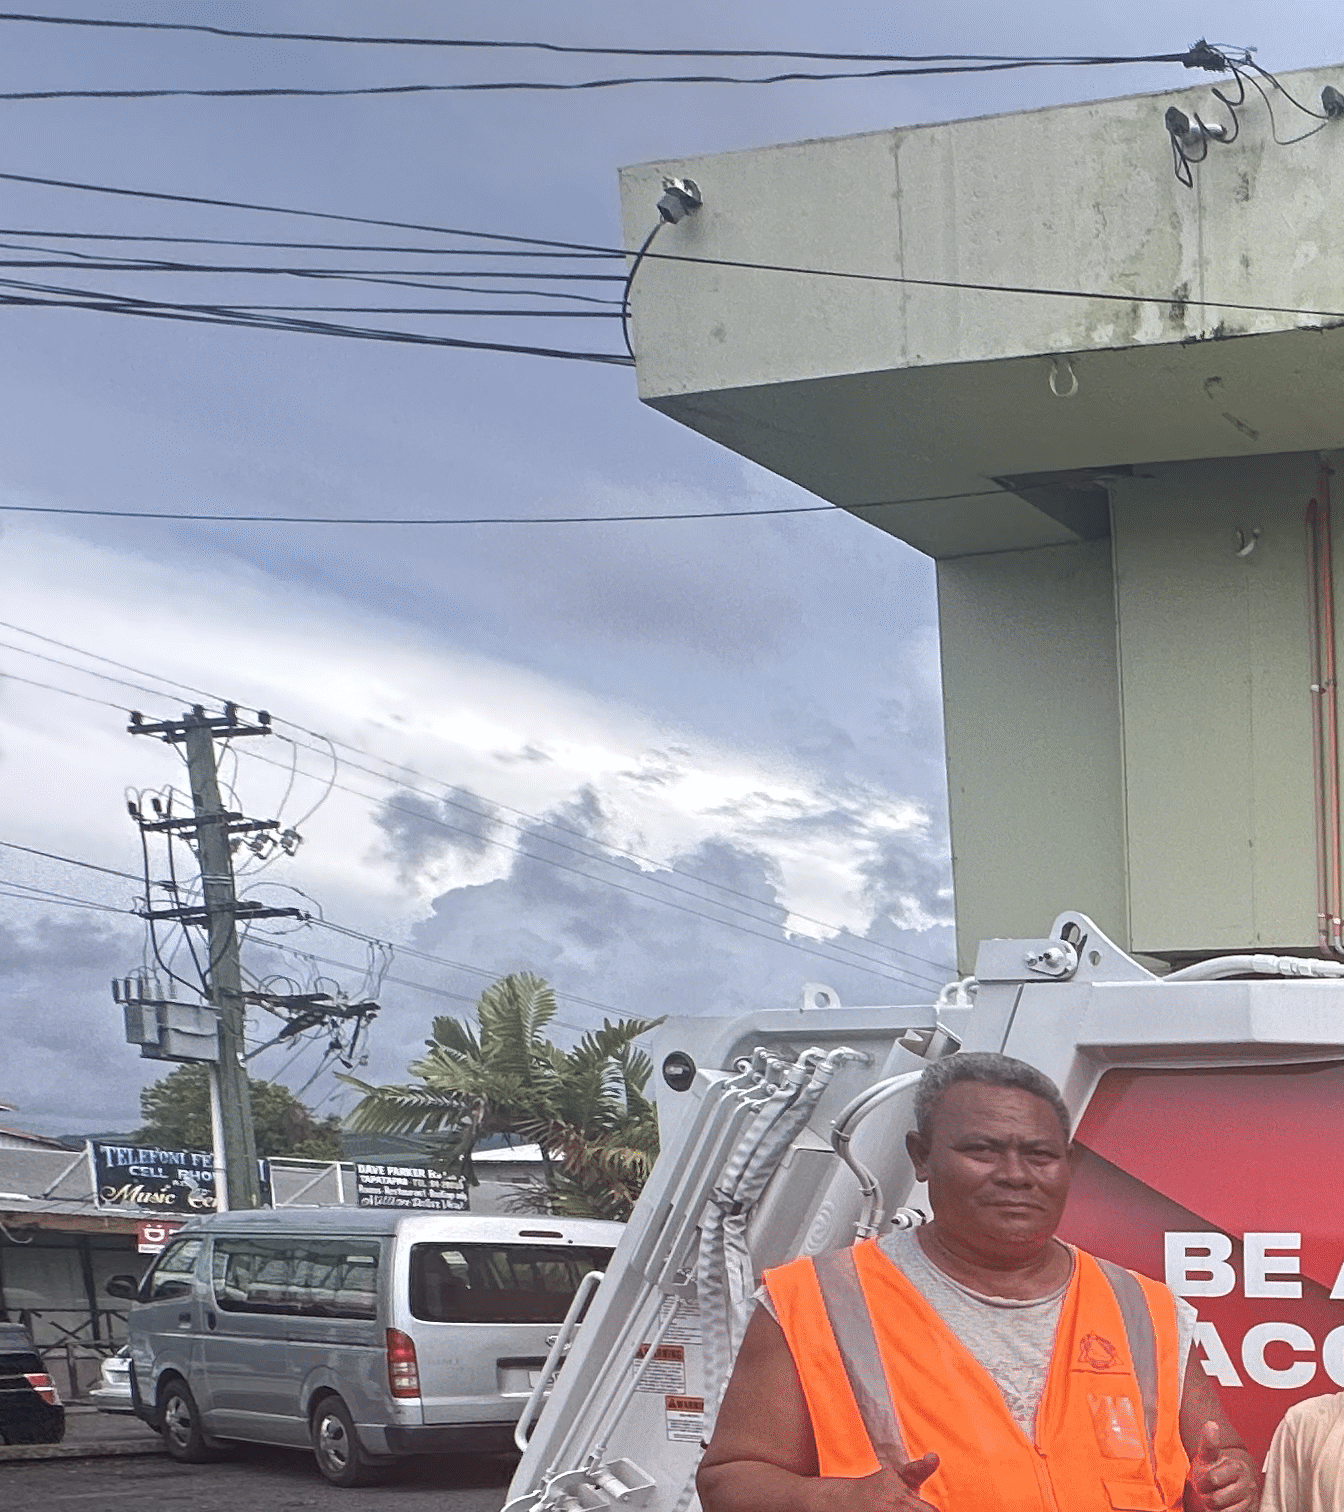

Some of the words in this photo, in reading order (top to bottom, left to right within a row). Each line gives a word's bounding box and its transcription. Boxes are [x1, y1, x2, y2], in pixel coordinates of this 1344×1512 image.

[128, 1166, 169, 1178] CELL
[101, 1183, 175, 1205] Music
[1164, 1231, 1303, 1300] BE
